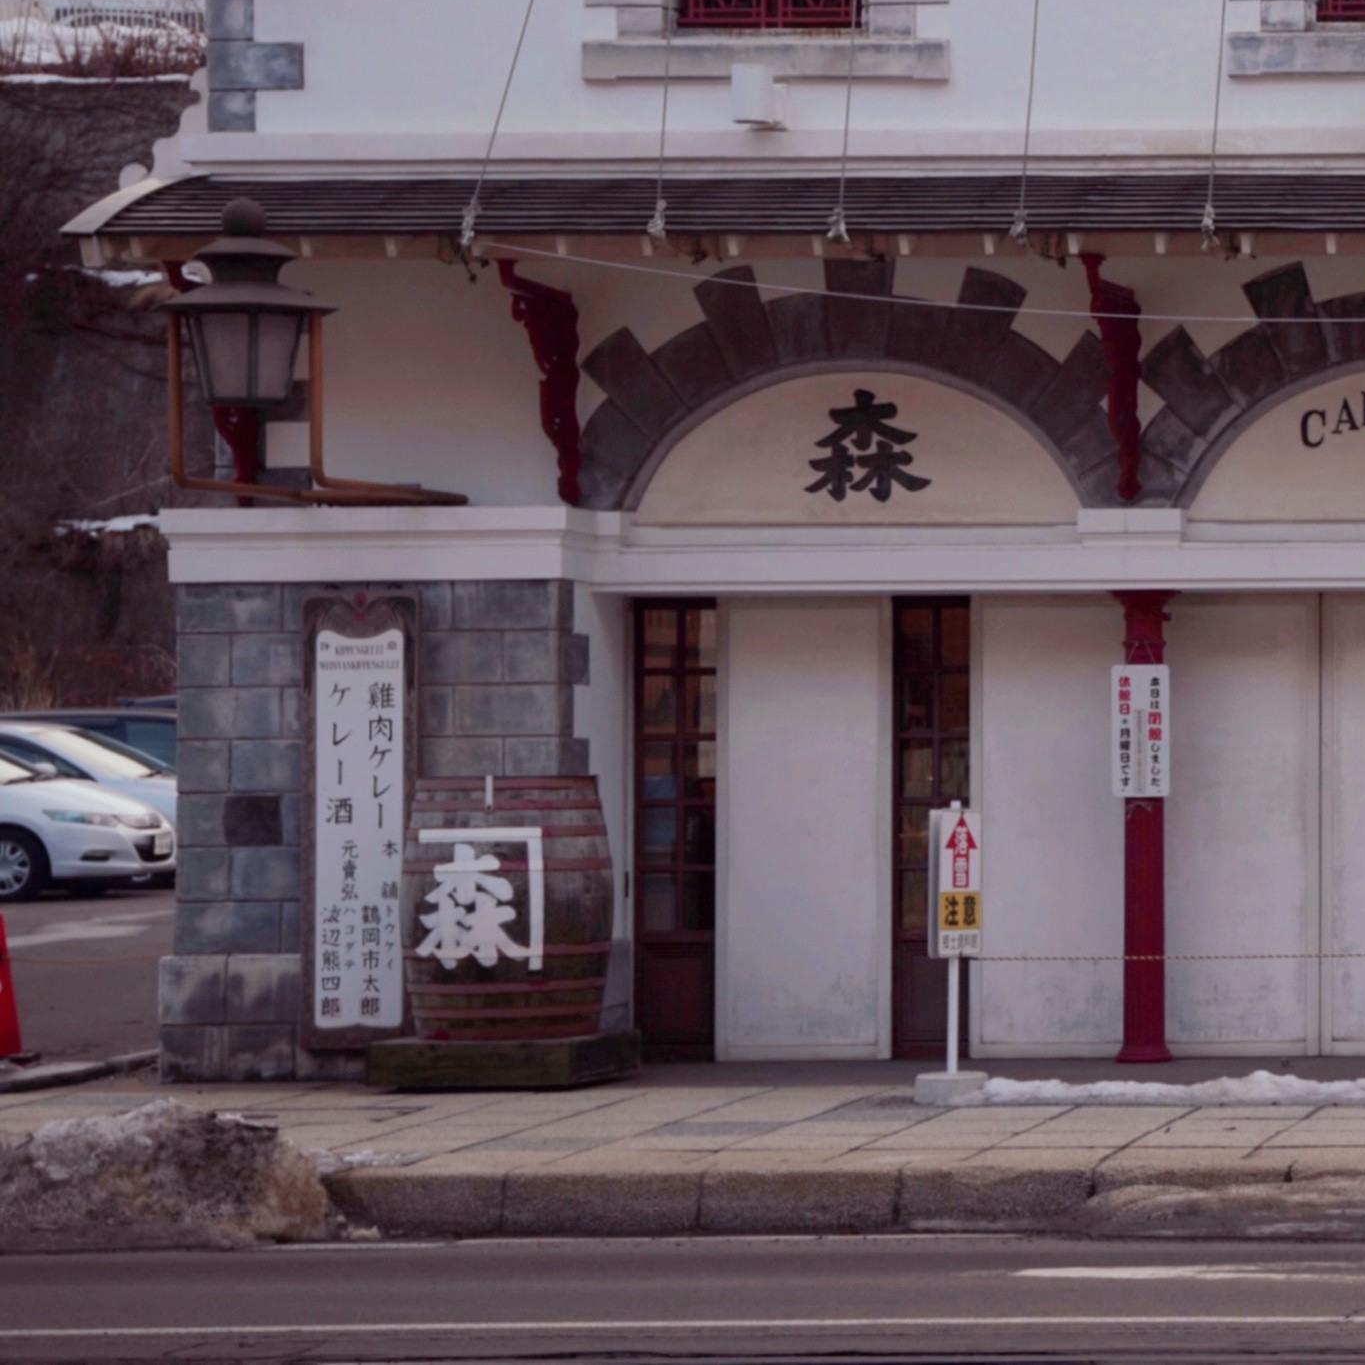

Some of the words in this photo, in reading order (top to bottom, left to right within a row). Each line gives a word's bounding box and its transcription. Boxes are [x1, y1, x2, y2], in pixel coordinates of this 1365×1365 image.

[802, 388, 933, 503] 森
[955, 826, 968, 886] 落雪
[415, 843, 530, 970] 森
[944, 895, 976, 926] 注意
